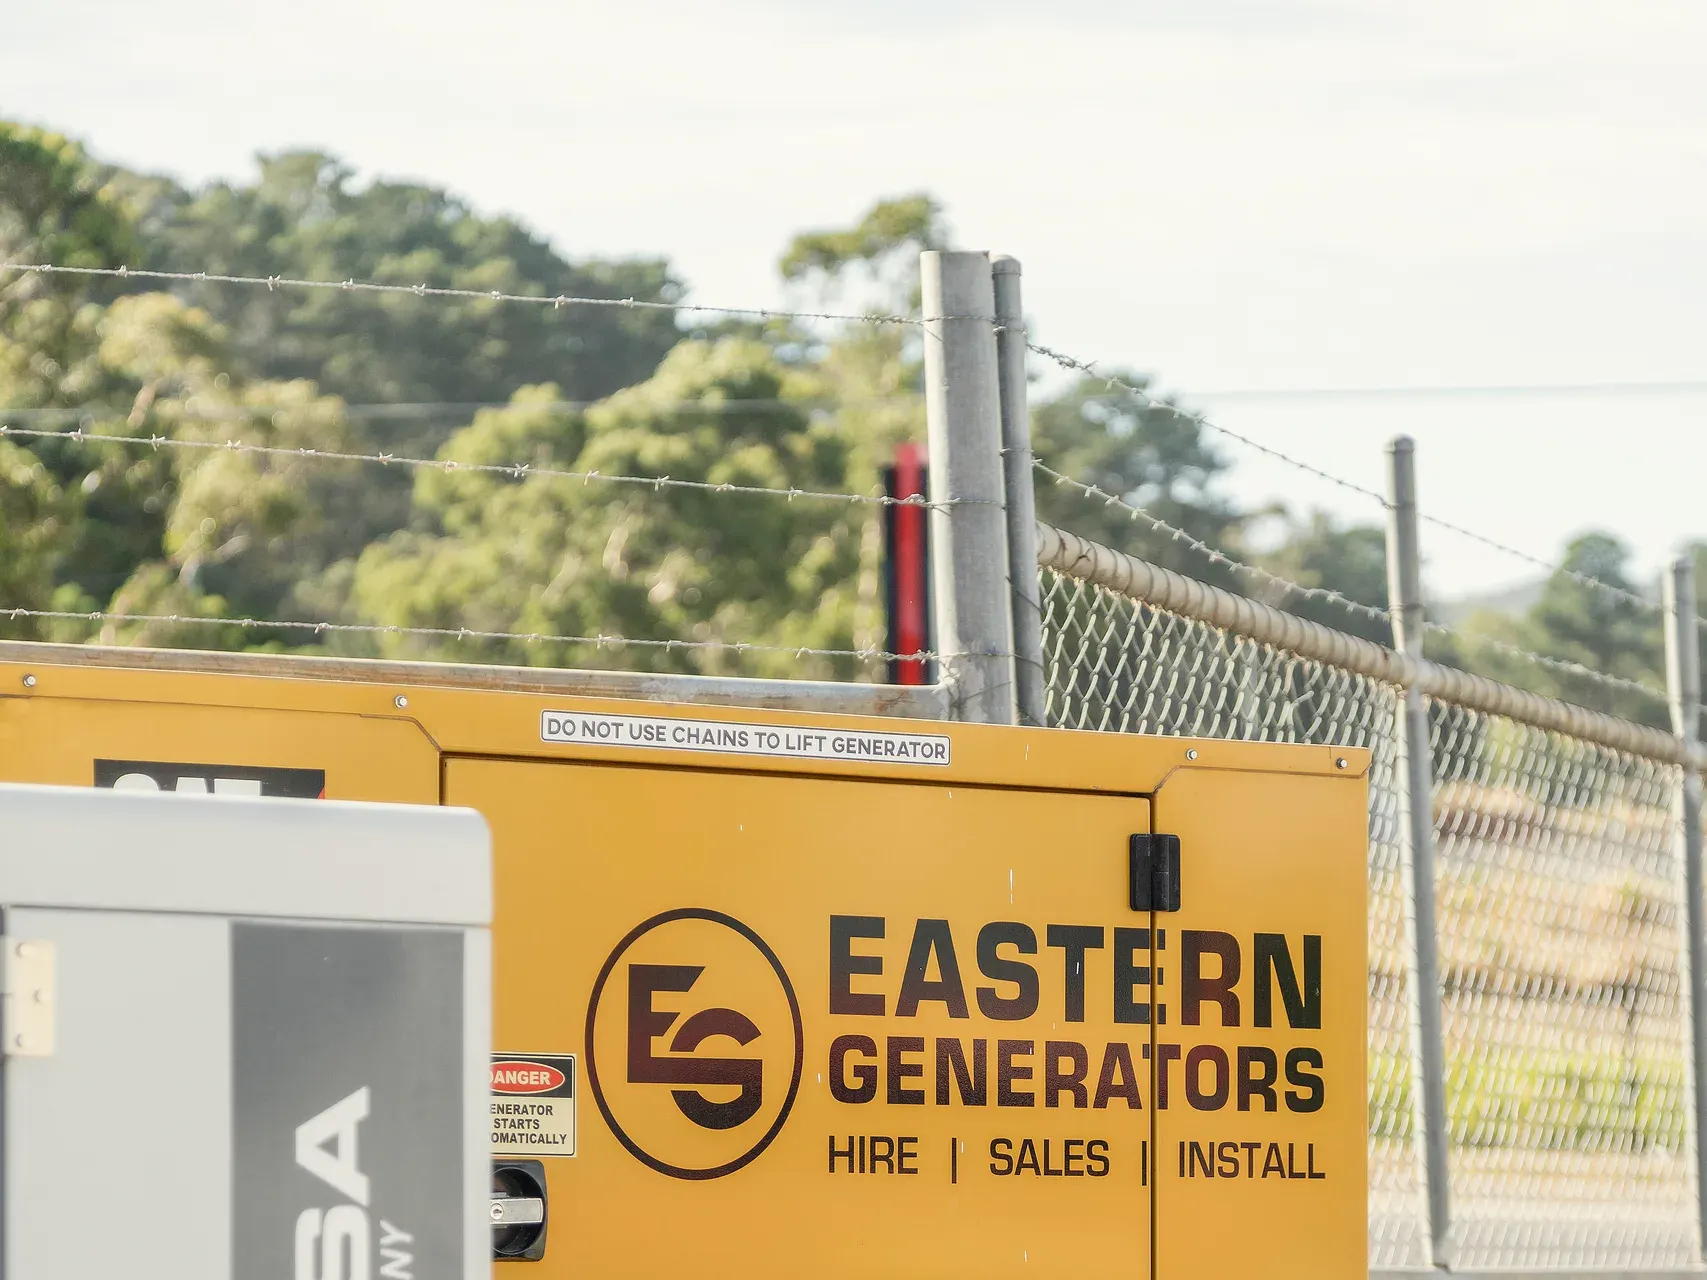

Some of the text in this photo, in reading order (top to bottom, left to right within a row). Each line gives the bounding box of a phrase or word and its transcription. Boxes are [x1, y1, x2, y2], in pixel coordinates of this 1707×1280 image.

[547, 717, 946, 759] DO NOT USE CHAINS TO LIFT GENERATOR
[829, 914, 1322, 1029] EASTERN
[828, 1035, 1325, 1113] GENERATORS
[489, 1103, 554, 1116] ENERATOR
[493, 1118, 540, 1130] STARTS
[490, 1132, 567, 1145] OMATICALLY
[827, 1135, 919, 1175] HIRE
[989, 1138, 1110, 1178] SALES
[1178, 1141, 1326, 1180] INSTALL
